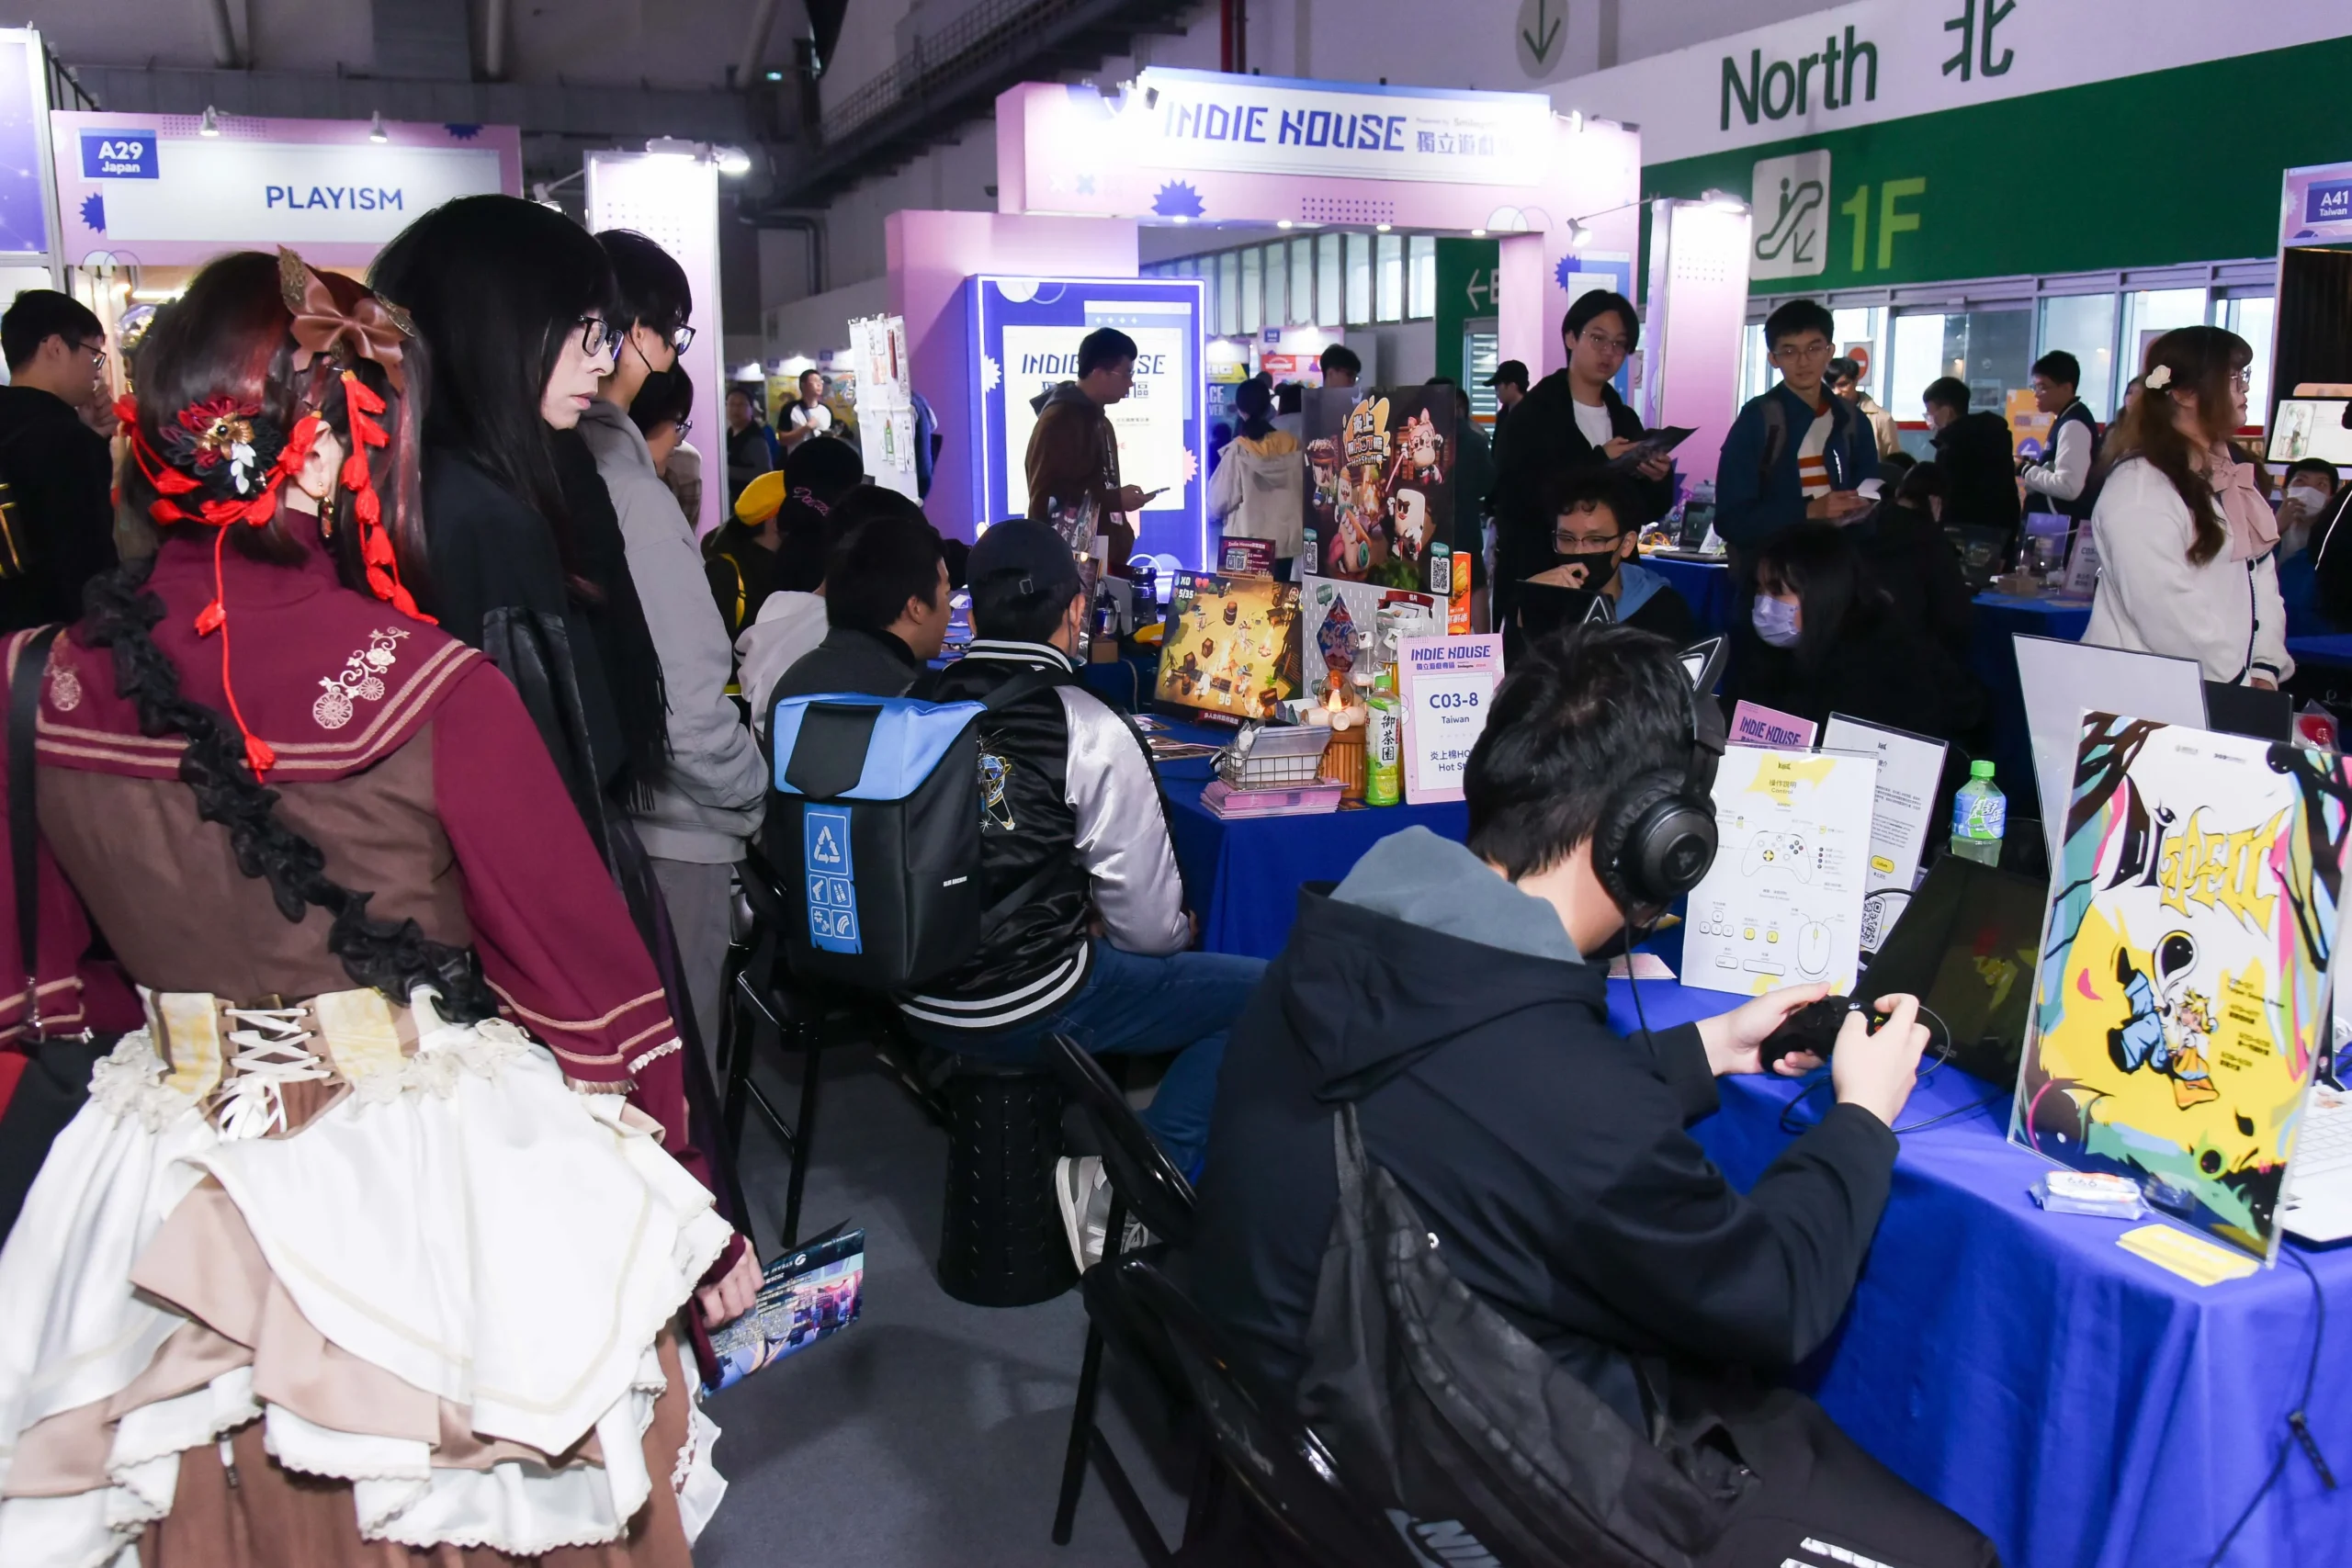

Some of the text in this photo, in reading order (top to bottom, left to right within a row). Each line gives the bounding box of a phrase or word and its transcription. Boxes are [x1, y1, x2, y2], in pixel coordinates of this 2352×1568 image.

[1941, 0, 2017, 82] 北
[1720, 25, 1878, 131] North
[1164, 101, 1408, 152] INDIE HOUSE
[97, 141, 143, 161] A29
[101, 161, 141, 175] Japan
[266, 186, 404, 211] PLAYISM
[2320, 190, 2349, 207] A41
[2319, 208, 2348, 217] Taiwan
[1841, 176, 1926, 272] 1F
[1410, 645, 1491, 661] INDIE HOUSE
[1429, 692, 1479, 709] C03-8
[1441, 715, 1470, 724] Taiwan
[1739, 716, 1767, 739] INDIE
[1381, 715, 1396, 761] 御茶園
[1430, 749, 1472, 761] 炎上棉HO
[1438, 762, 1455, 773] Hot
